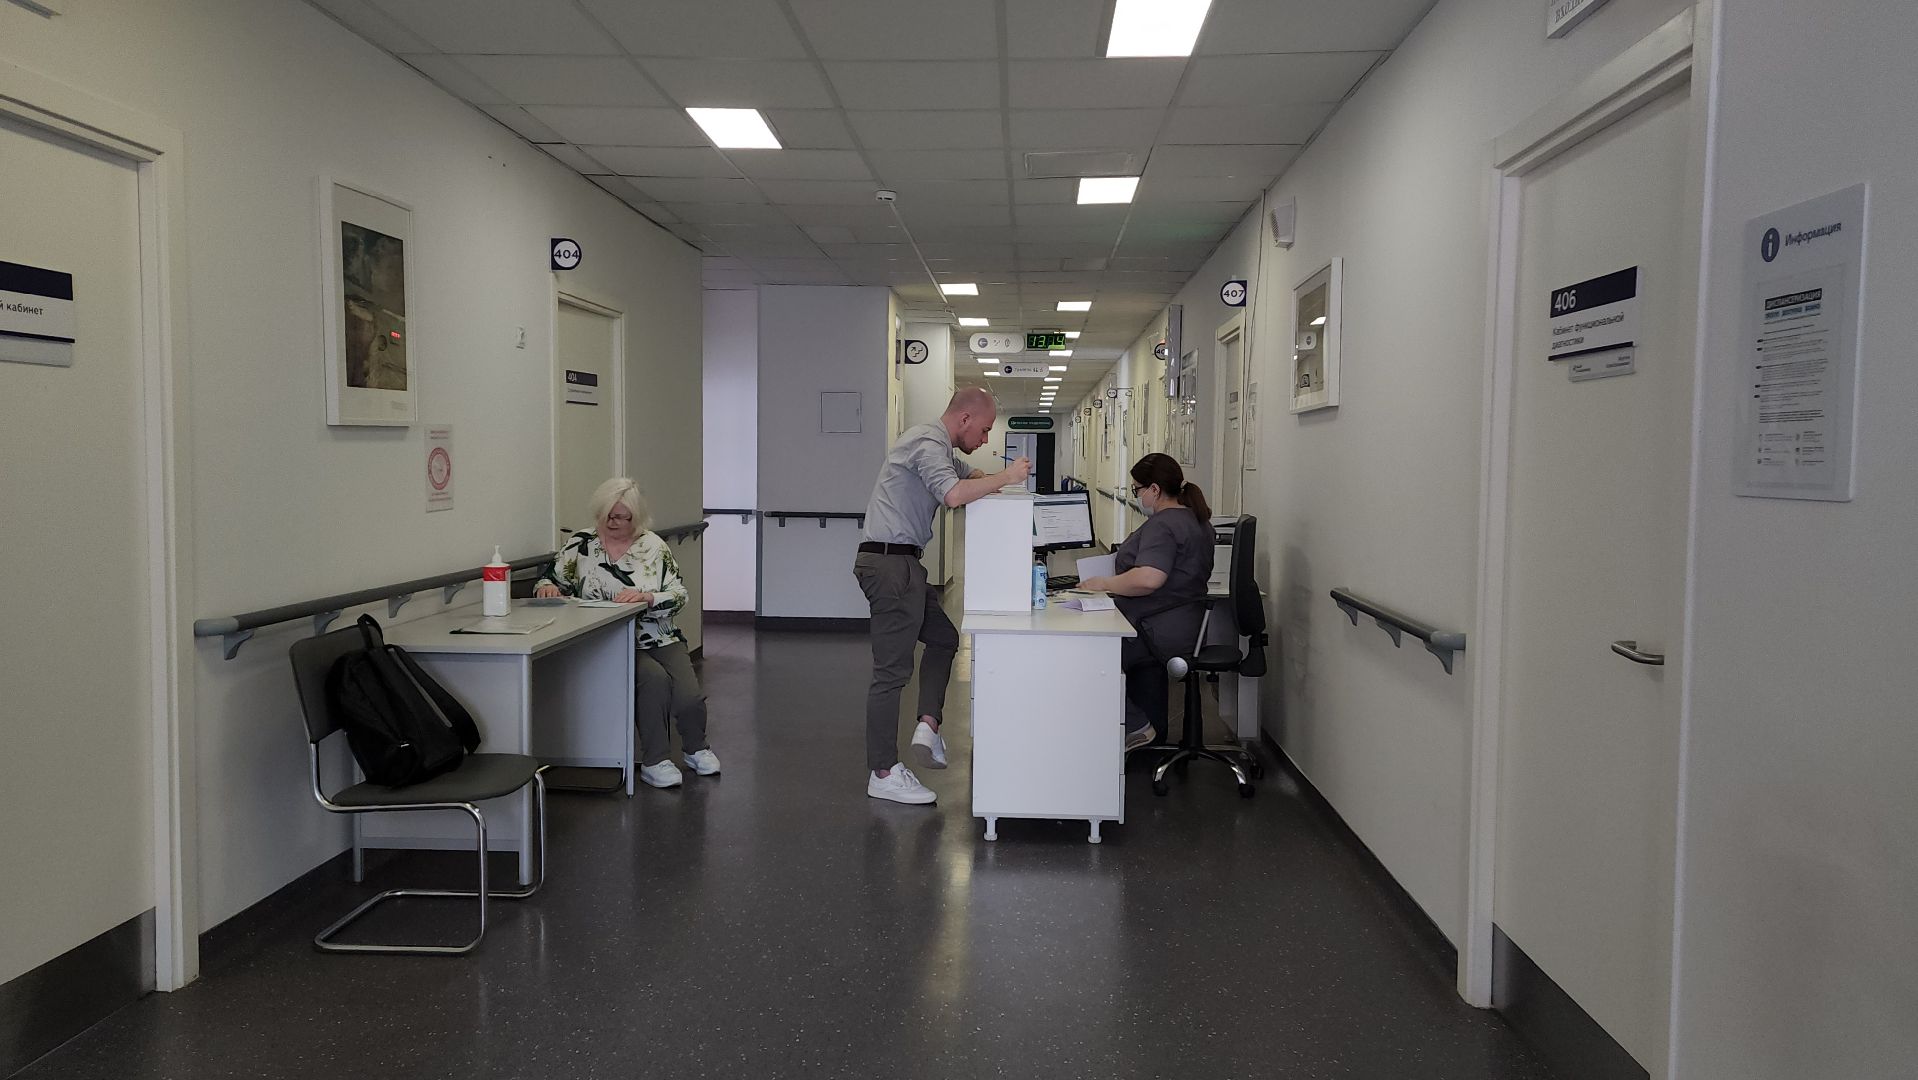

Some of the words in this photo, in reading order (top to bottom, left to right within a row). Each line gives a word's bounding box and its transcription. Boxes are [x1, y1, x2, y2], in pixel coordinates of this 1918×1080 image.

[1785, 222, 1842, 247] Информация
[553, 249, 580, 259] 404
[1223, 289, 1246, 298] 407
[1554, 289, 1577, 312] 406
[6, 303, 44, 315] кабинет
